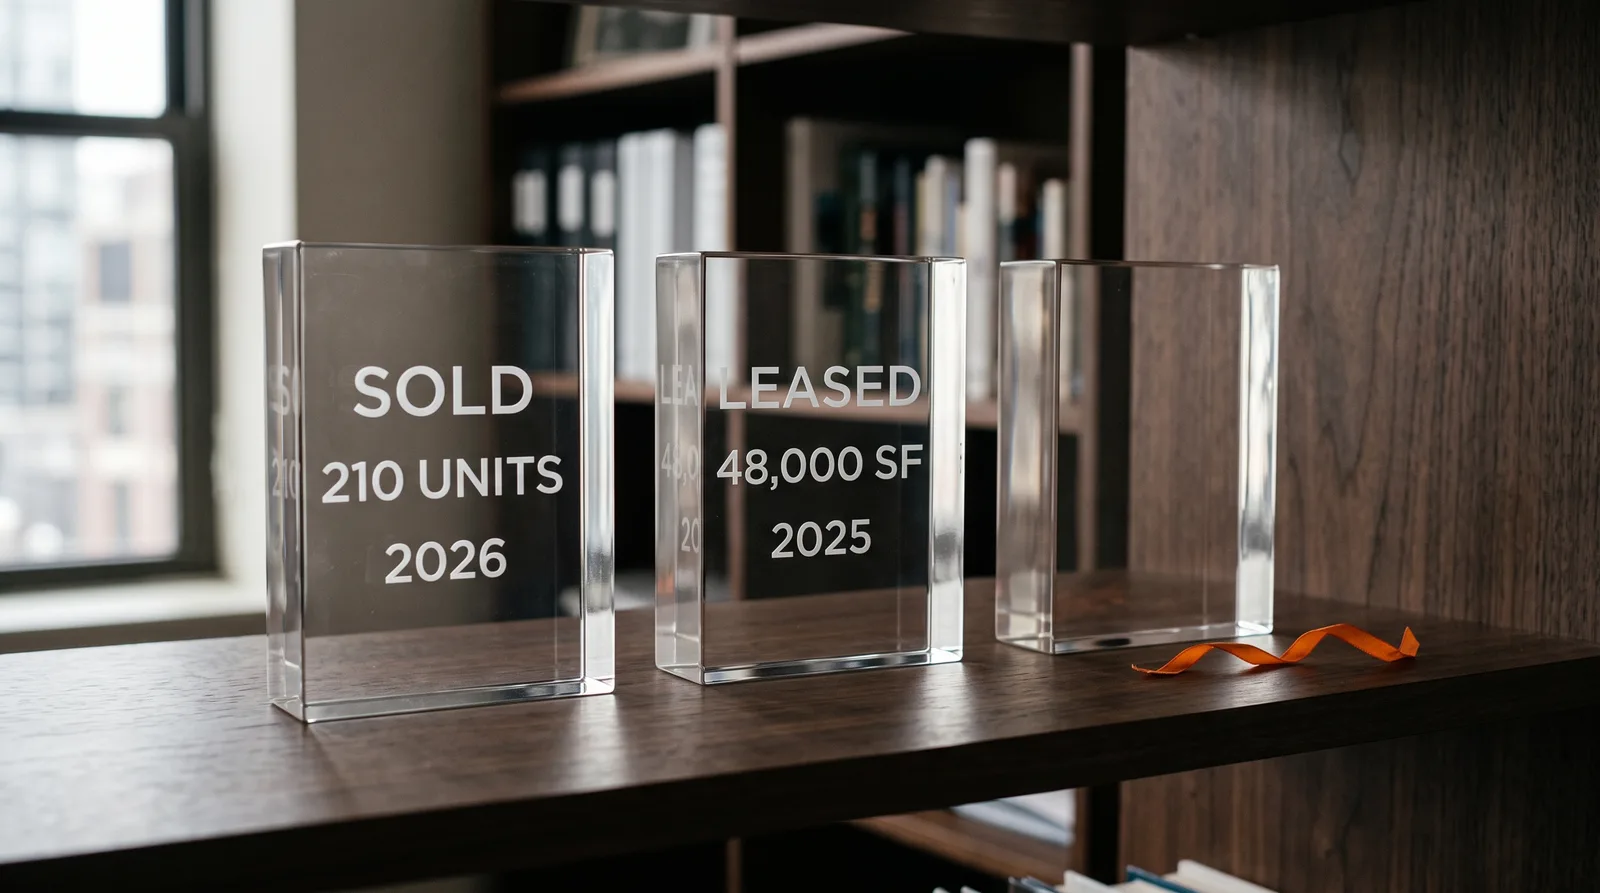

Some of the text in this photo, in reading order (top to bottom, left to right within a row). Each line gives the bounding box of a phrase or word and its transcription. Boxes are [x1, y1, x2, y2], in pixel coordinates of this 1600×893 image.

[353, 365, 533, 418] SOLD
[719, 365, 922, 410] LEASED
[322, 454, 564, 504] 210 UNITS
[716, 444, 924, 491] 48,000 SF
[385, 537, 507, 584] 2026
[771, 518, 872, 559] 2025
